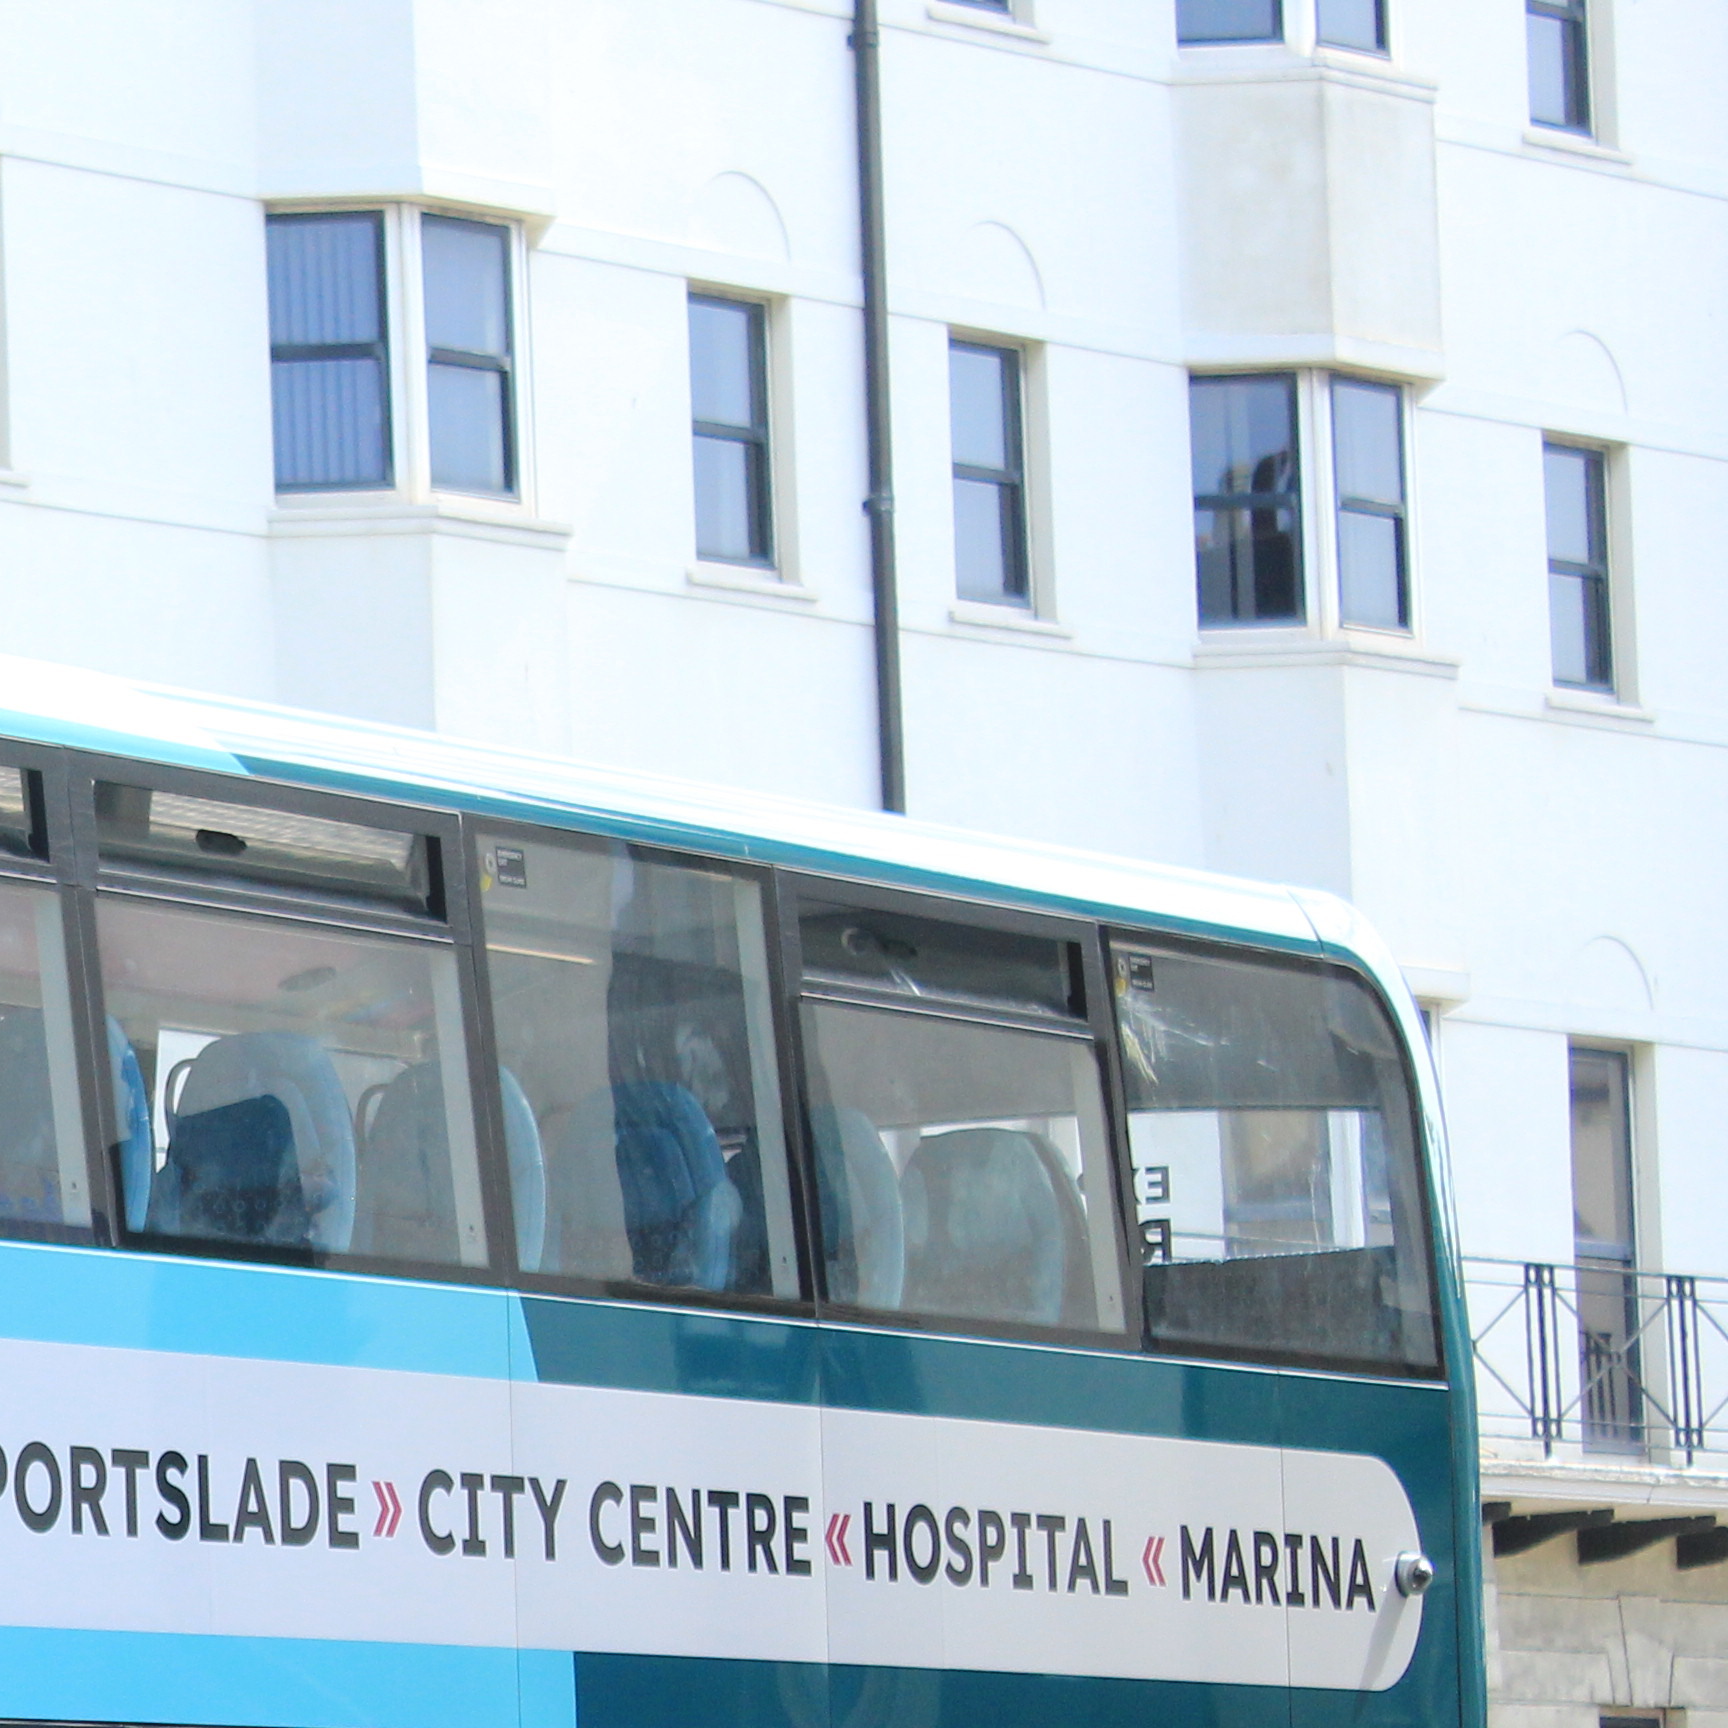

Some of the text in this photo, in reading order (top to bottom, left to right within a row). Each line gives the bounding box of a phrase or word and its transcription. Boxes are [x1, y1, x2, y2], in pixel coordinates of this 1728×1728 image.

[417, 1468, 568, 1562] CITY
[589, 1480, 812, 1577] CENTRE
[863, 1501, 1130, 1597] HOSPITAL
[1180, 1524, 1377, 1613] MARINA
